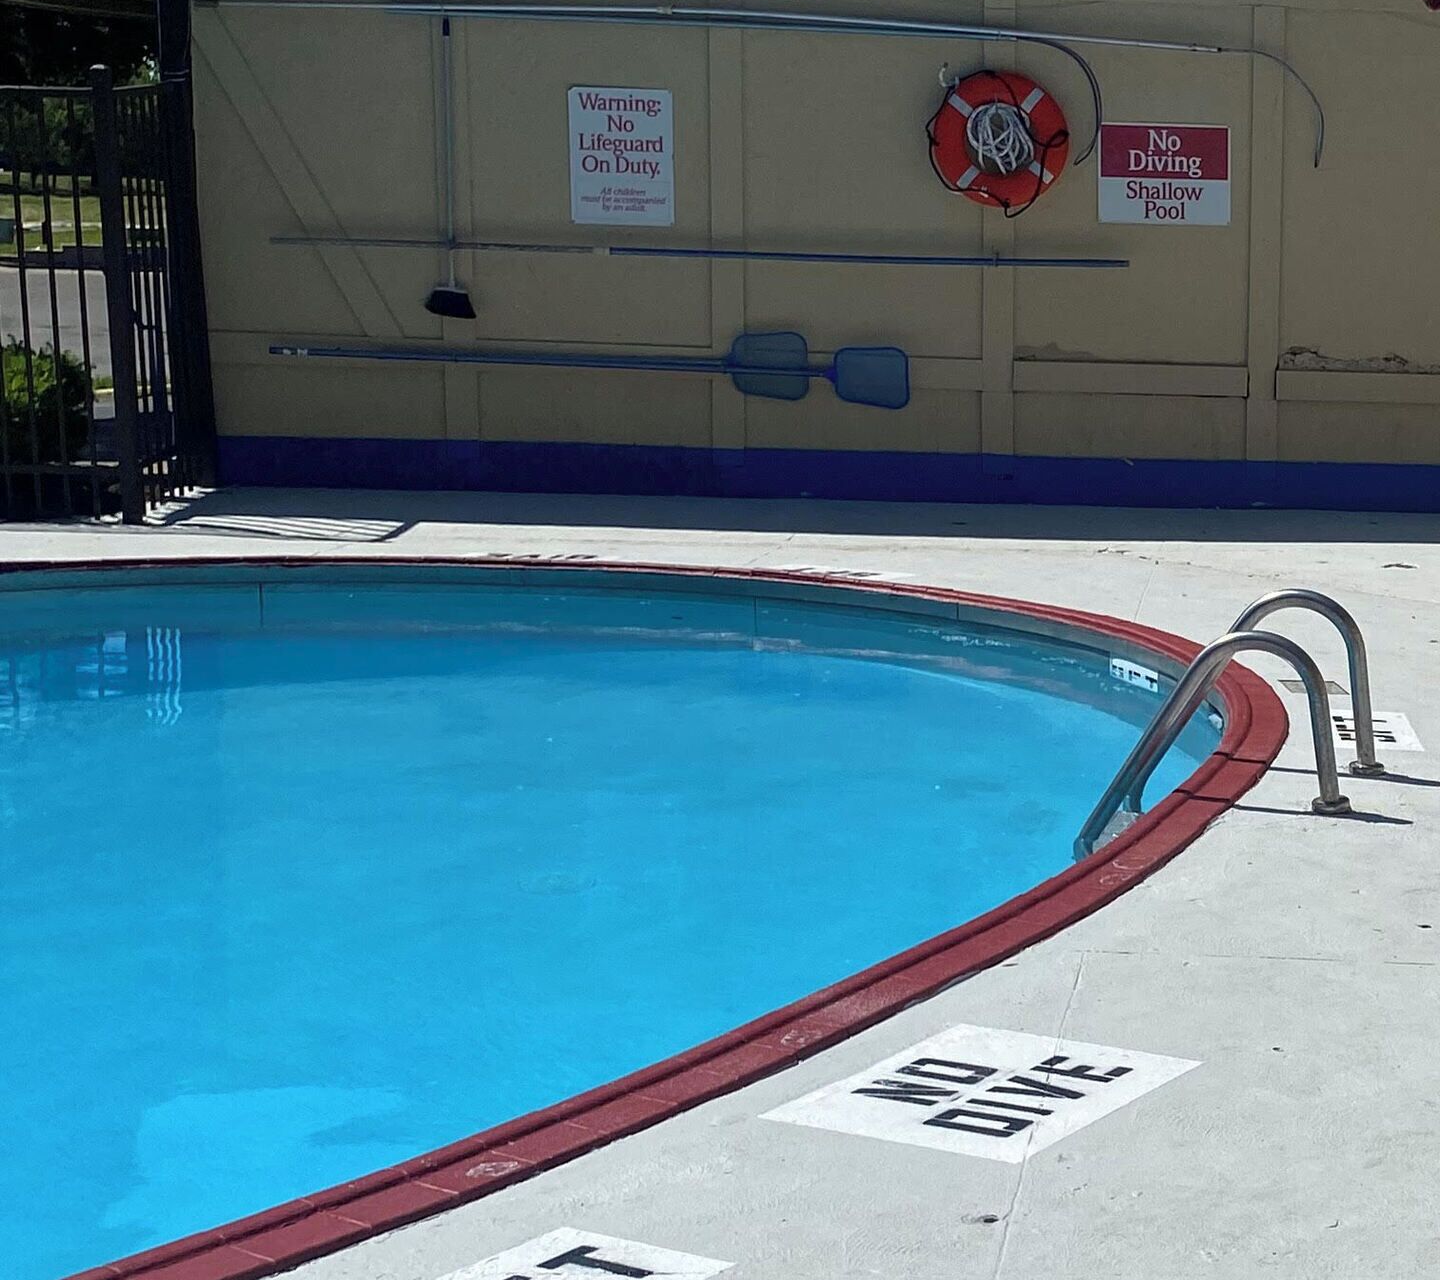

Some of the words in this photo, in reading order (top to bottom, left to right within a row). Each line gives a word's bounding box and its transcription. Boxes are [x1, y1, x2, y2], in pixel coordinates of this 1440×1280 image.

[578, 92, 662, 117] Warning:
[607, 115, 635, 132] No
[578, 133, 664, 157] Lifeguard
[1148, 129, 1181, 151] No
[582, 155, 610, 173] On
[616, 156, 661, 179] Duty.
[1128, 150, 1202, 177] Diving
[1126, 181, 1204, 202] Shallow
[1143, 201, 1186, 220] Pool
[850, 1057, 999, 1107] NO
[921, 1055, 1135, 1139] DIVE
